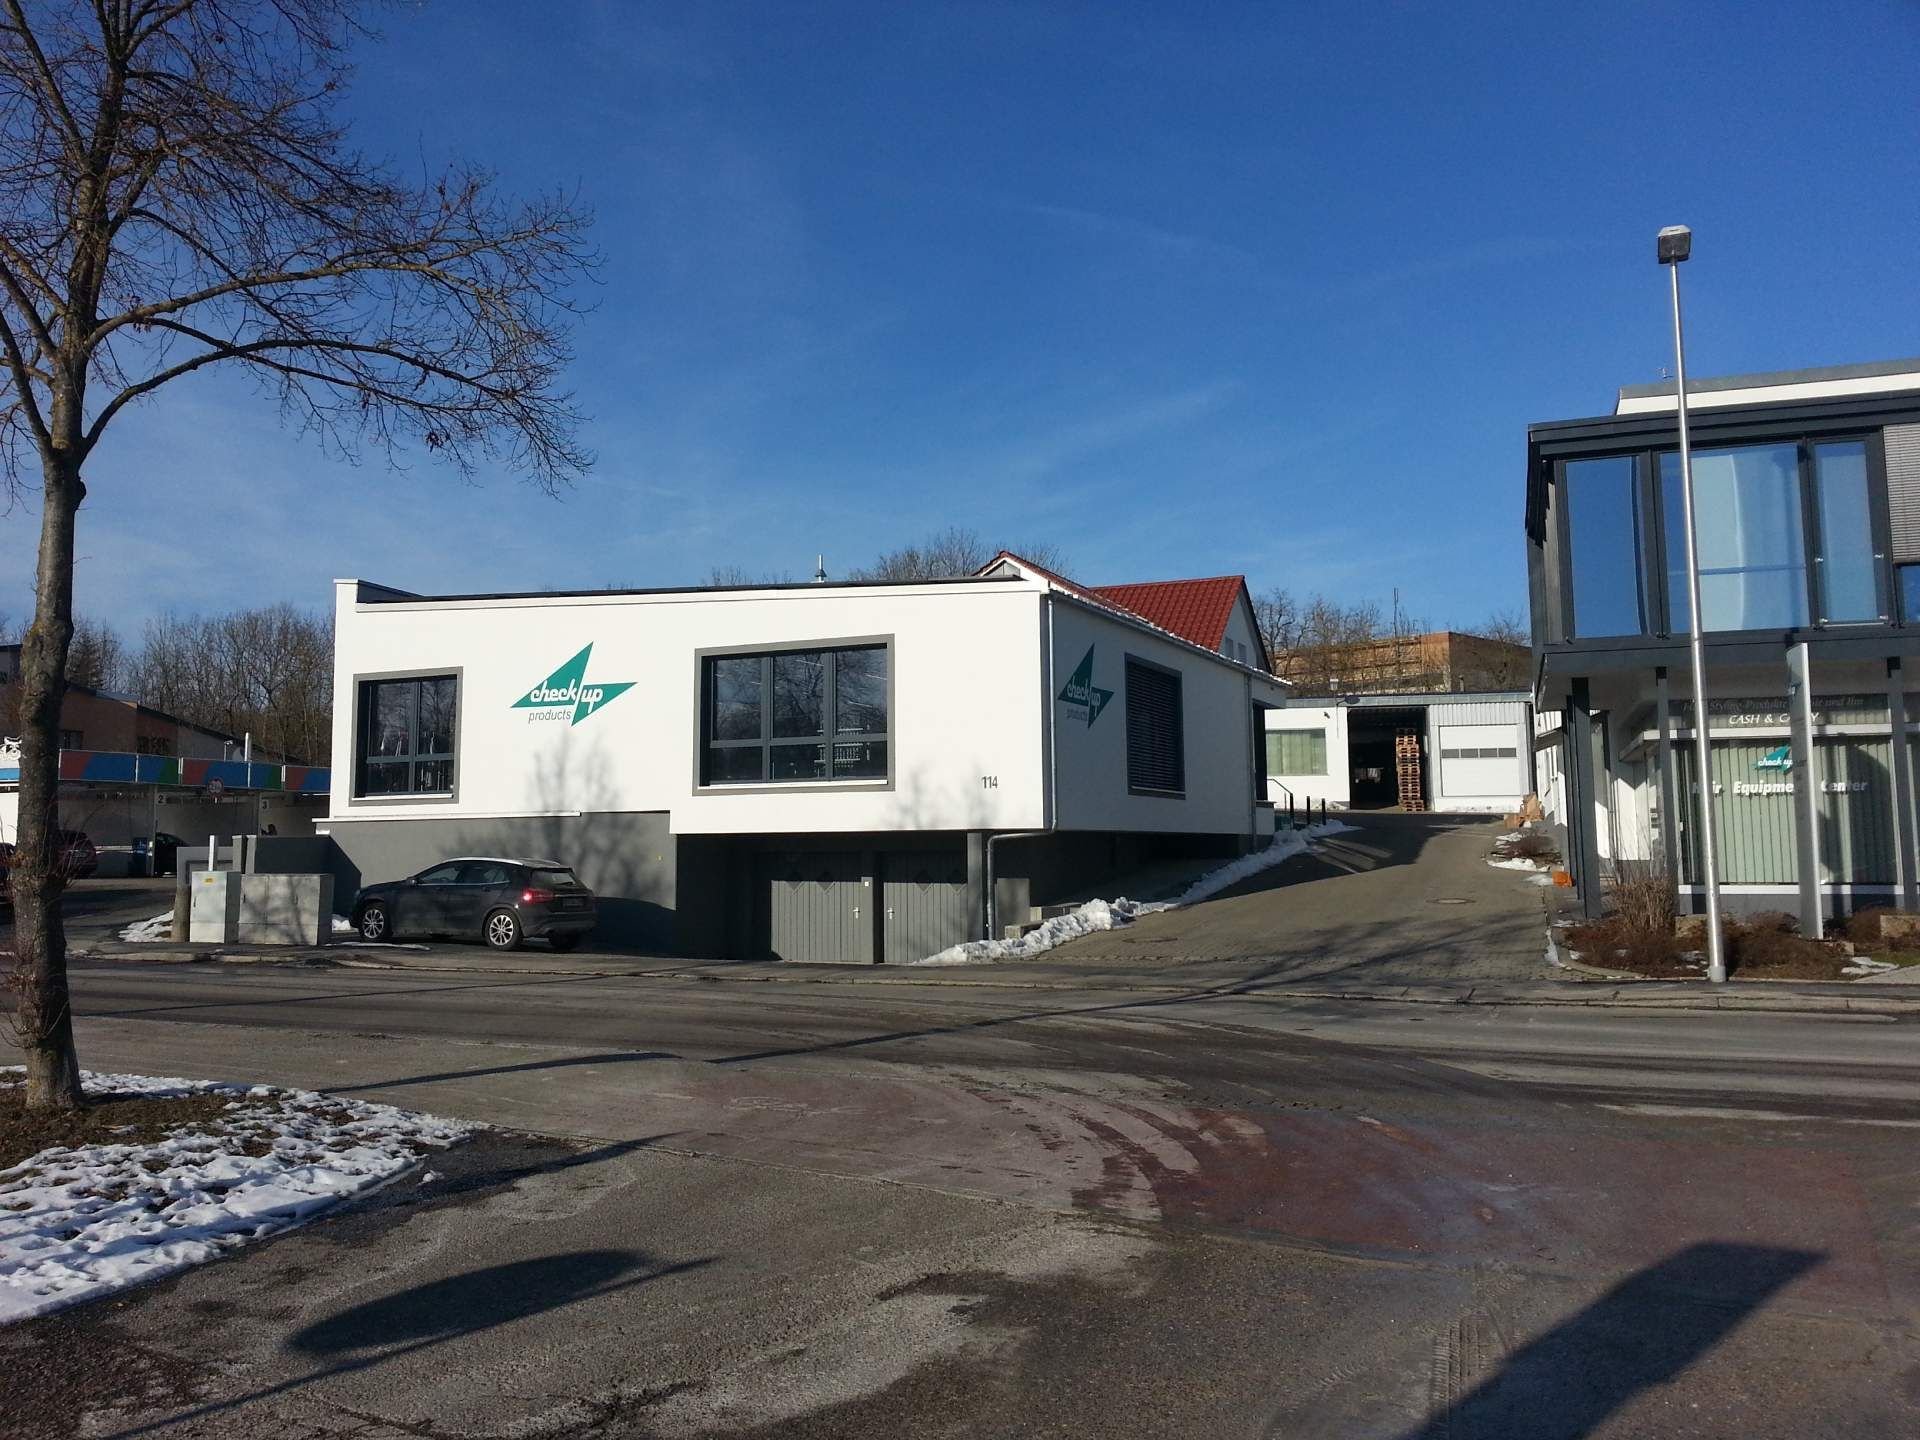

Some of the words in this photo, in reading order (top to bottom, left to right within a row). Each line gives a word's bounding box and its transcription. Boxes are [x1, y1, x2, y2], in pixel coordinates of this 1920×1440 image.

[1067, 675, 1089, 700] check
[530, 678, 577, 703] check
[580, 687, 604, 713] up
[528, 709, 572, 724] products
[1728, 714, 1760, 724] CASH
[1764, 714, 1773, 723] &
[1757, 757, 1782, 766] check
[981, 776, 998, 789] 114
[1733, 780, 1794, 798] Equipme
